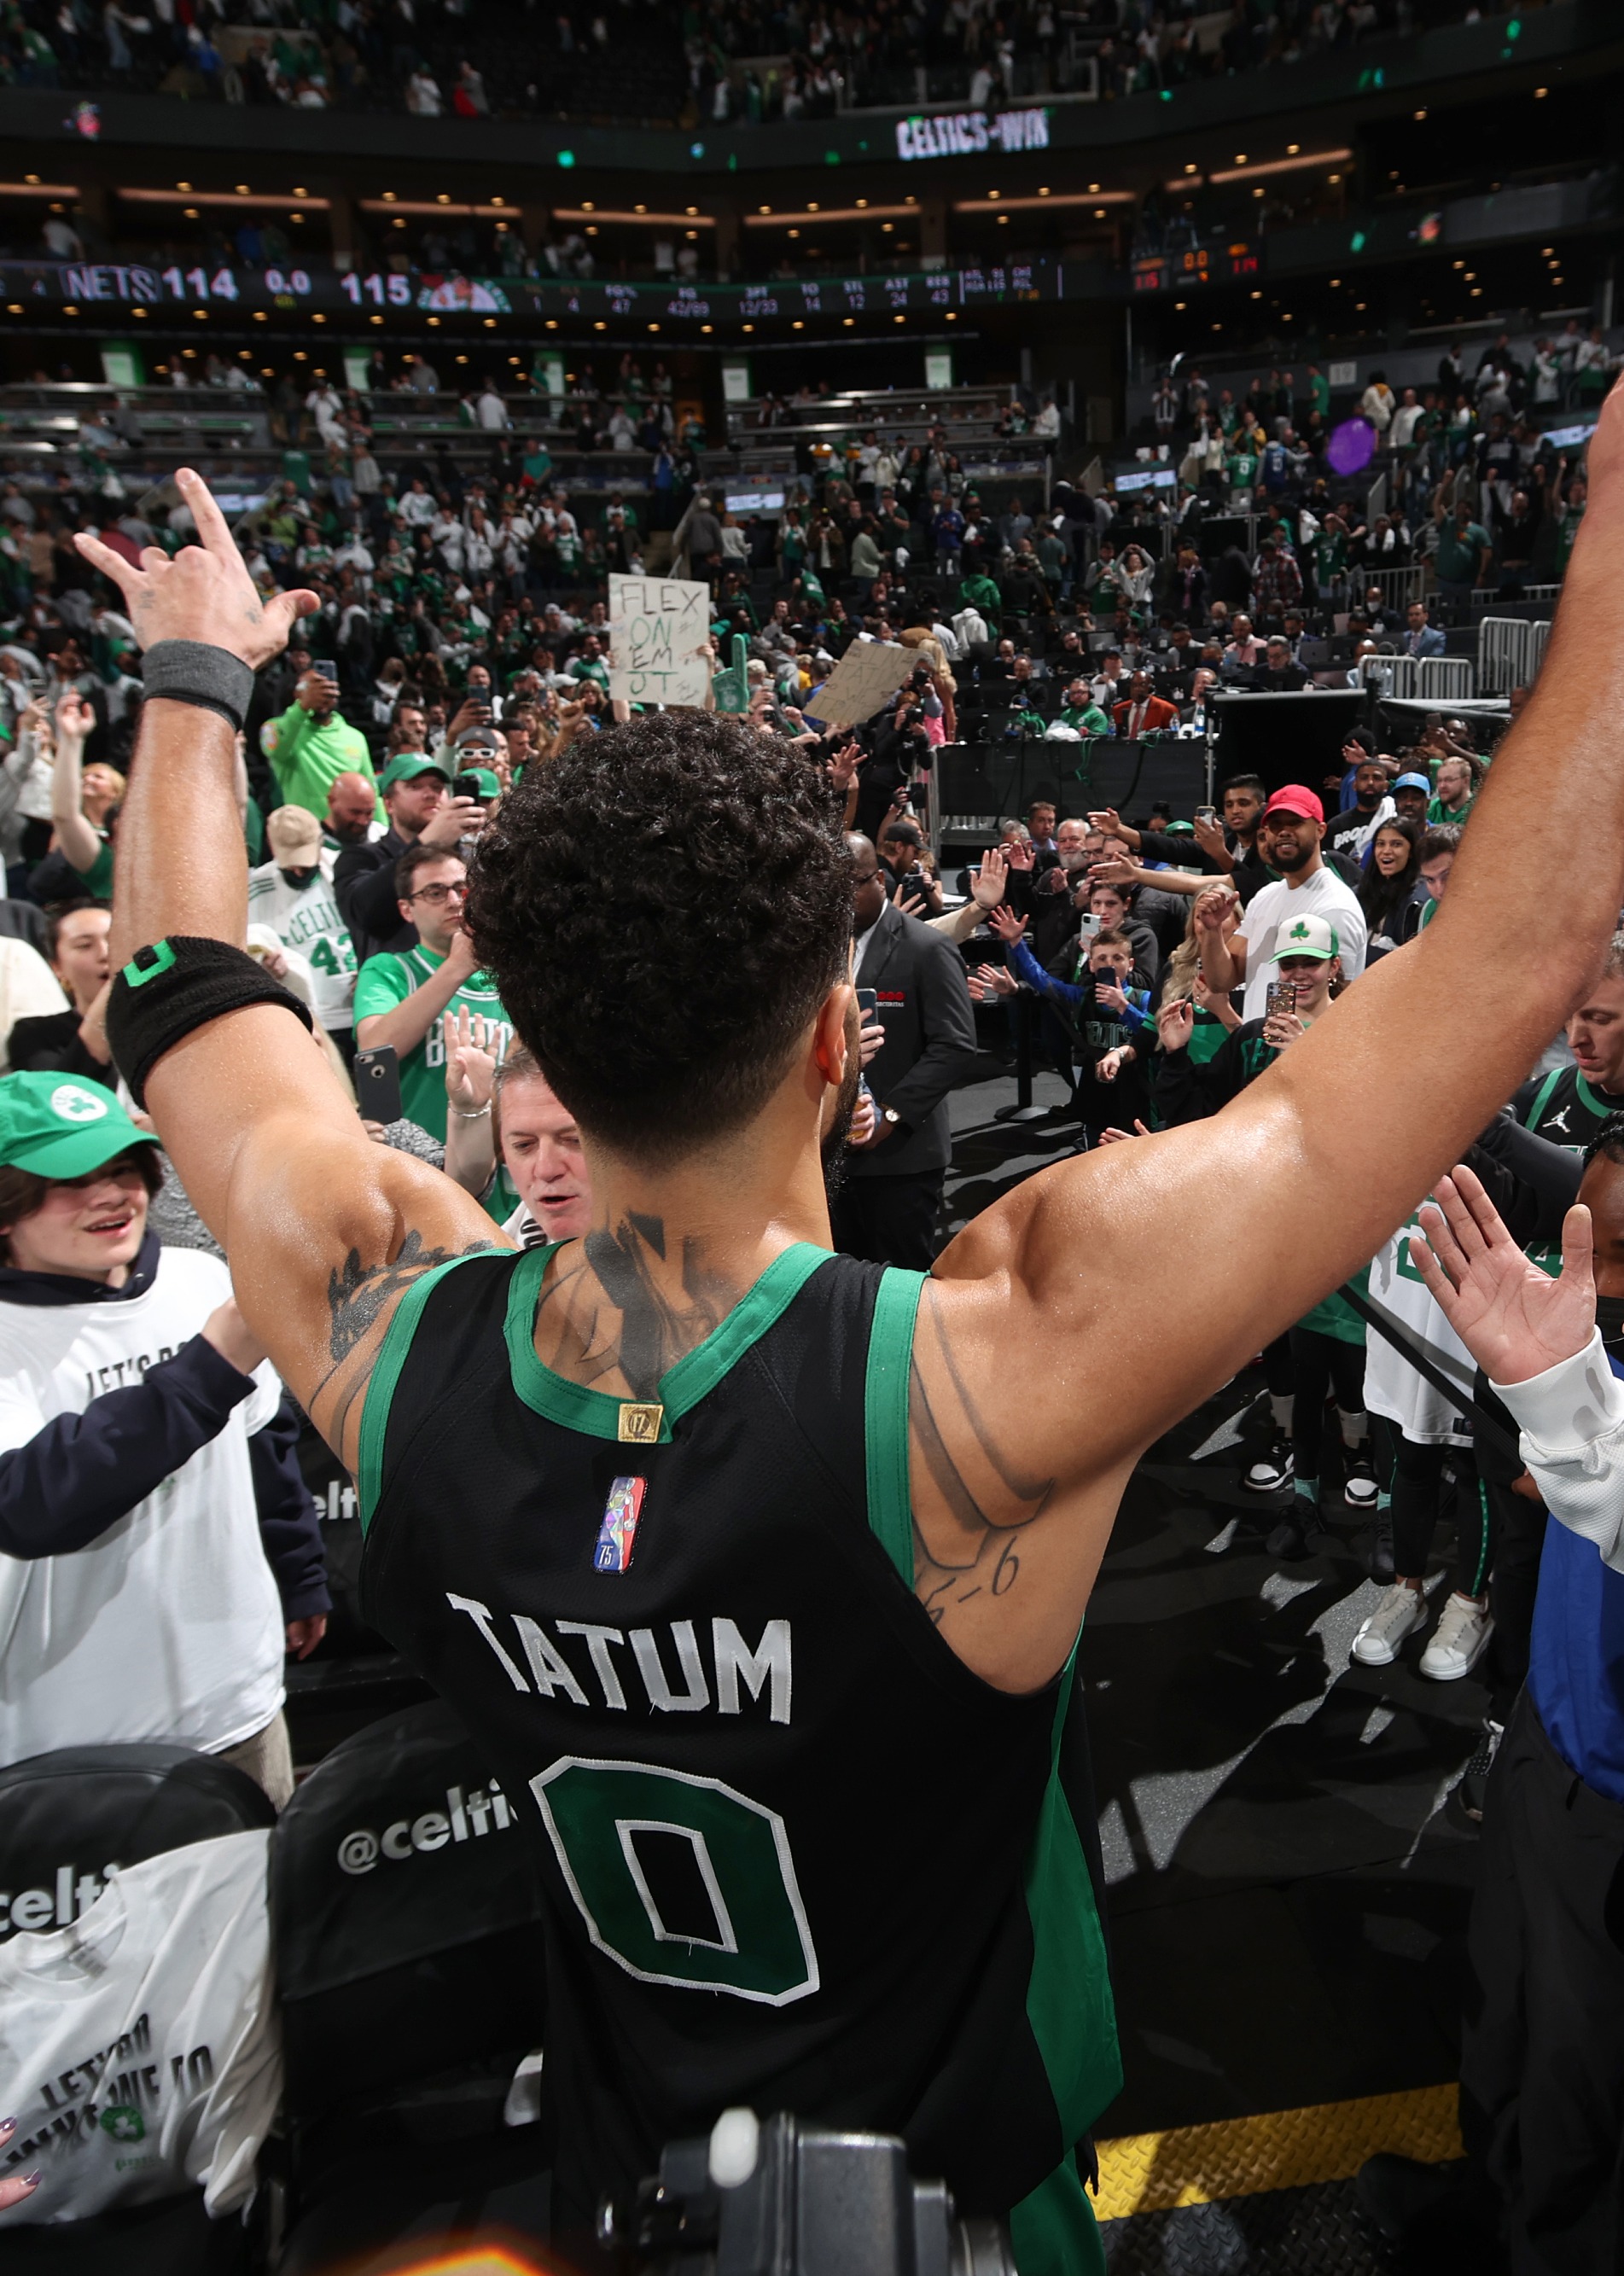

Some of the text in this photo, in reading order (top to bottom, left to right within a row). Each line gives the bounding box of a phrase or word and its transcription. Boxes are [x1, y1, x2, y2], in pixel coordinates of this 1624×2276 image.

[65, 265, 411, 306] NETS 114 0.0 115
[621, 582, 702, 615] FLEX
[630, 616, 672, 647] ON
[625, 670, 679, 696] JT
[310, 932, 358, 976] 42
[599, 1545, 613, 1566] 75
[446, 1592, 792, 1726] TATUM
[337, 1778, 519, 1875] @celti
[528, 1755, 821, 2007] 0
